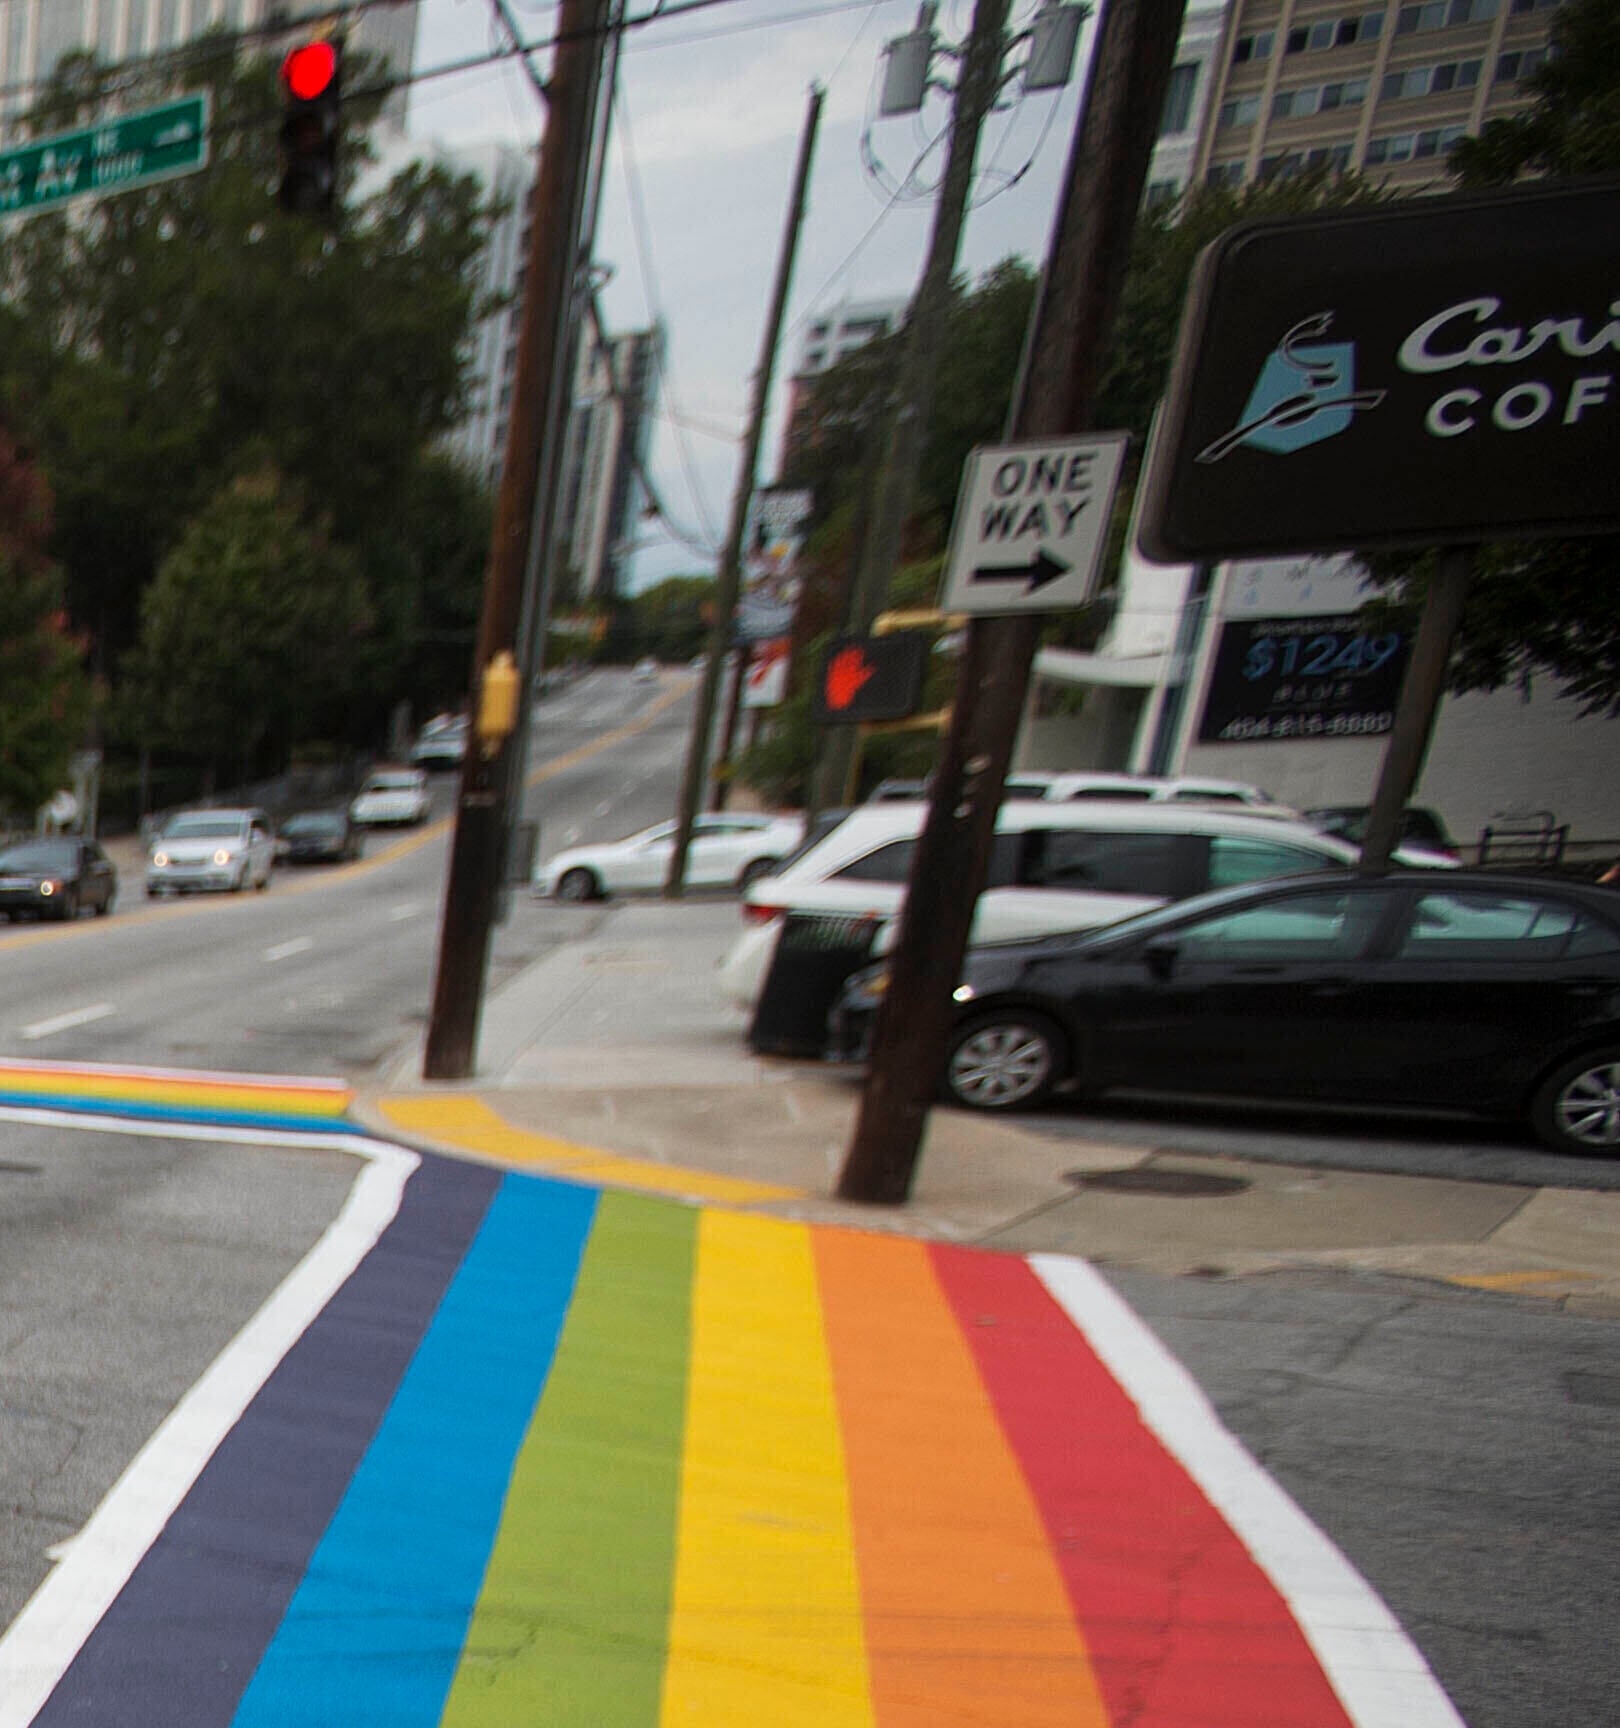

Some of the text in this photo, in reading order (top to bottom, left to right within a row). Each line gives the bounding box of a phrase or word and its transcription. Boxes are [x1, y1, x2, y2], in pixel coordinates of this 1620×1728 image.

[1424, 375, 1612, 438] COF
[991, 451, 1099, 496] ONE
[978, 498, 1091, 543] WAY
[1241, 632, 1401, 681] $1249
